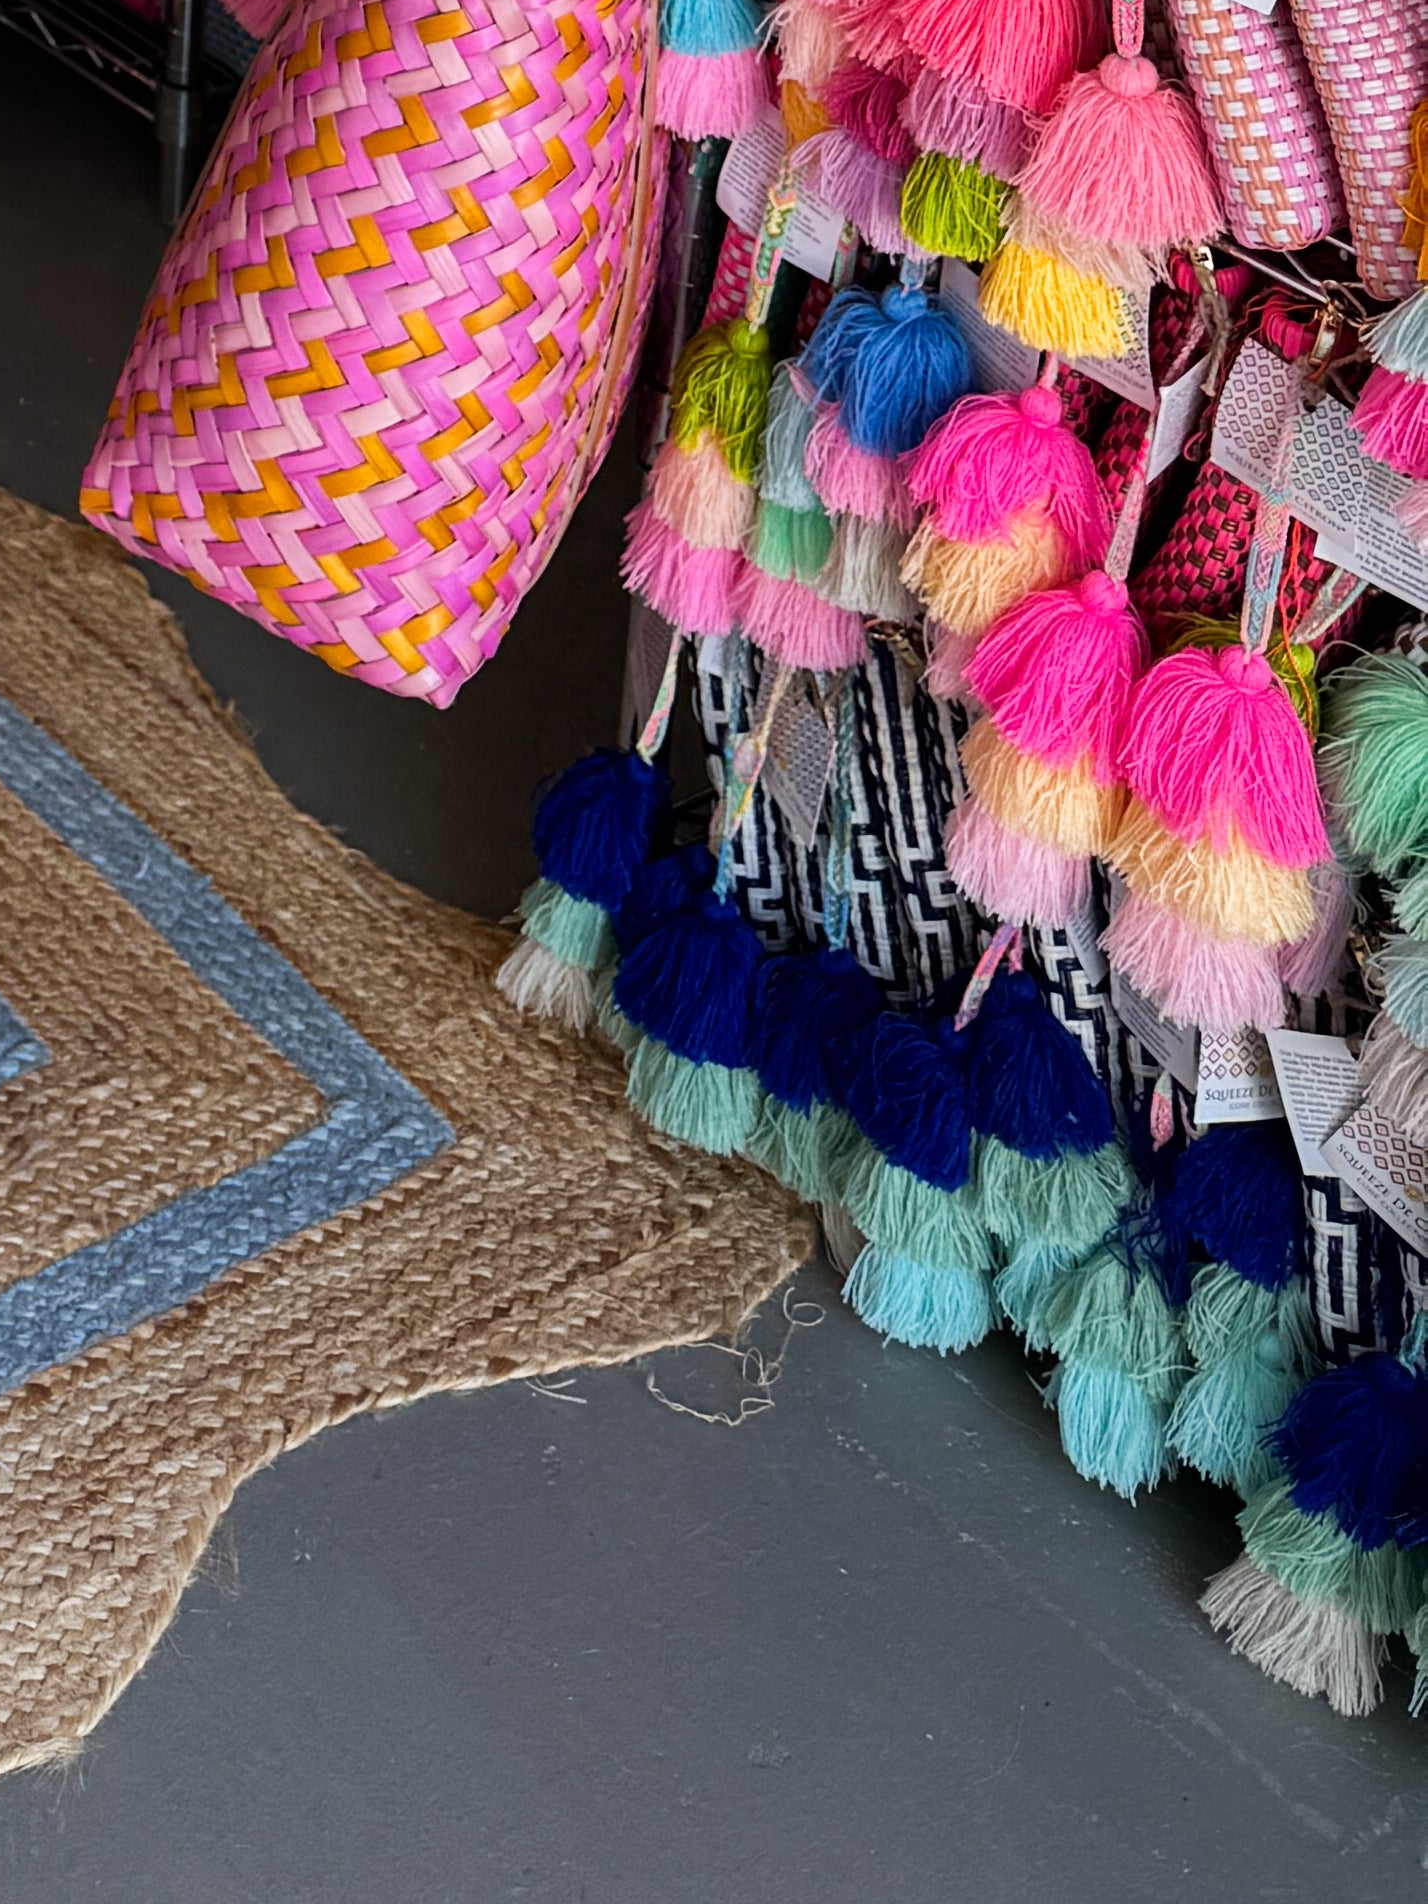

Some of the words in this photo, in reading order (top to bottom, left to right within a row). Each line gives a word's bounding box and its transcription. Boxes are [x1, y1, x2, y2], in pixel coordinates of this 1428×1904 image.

[1204, 1087, 1254, 1102] SQUEEZE
[1336, 1143, 1390, 1197] SQUEEZE
[1392, 1197, 1413, 1217] DE
